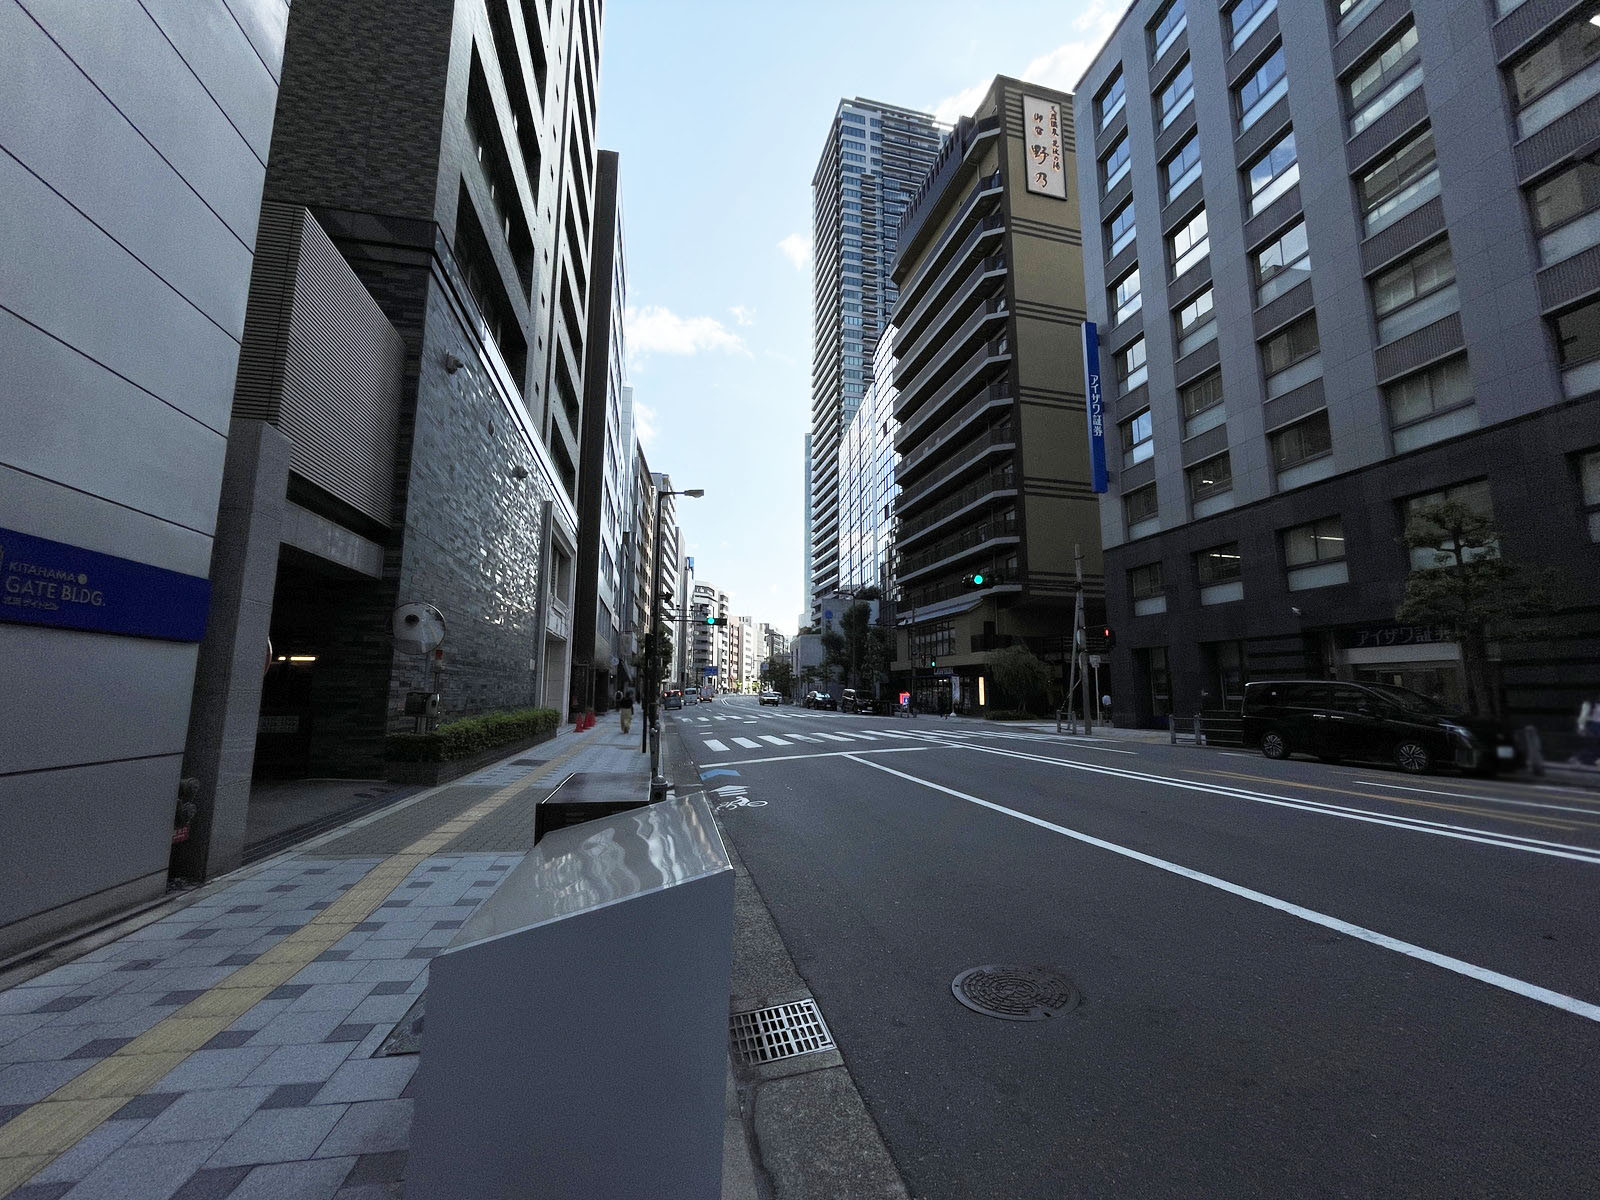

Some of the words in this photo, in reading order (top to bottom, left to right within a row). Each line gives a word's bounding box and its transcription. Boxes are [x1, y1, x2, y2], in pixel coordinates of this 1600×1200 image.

[1090, 375, 1103, 436] アイザワ証券
[9, 562, 77, 583] KITAHAMA
[6, 575, 57, 599] GATE
[61, 585, 106, 607] BLDG.
